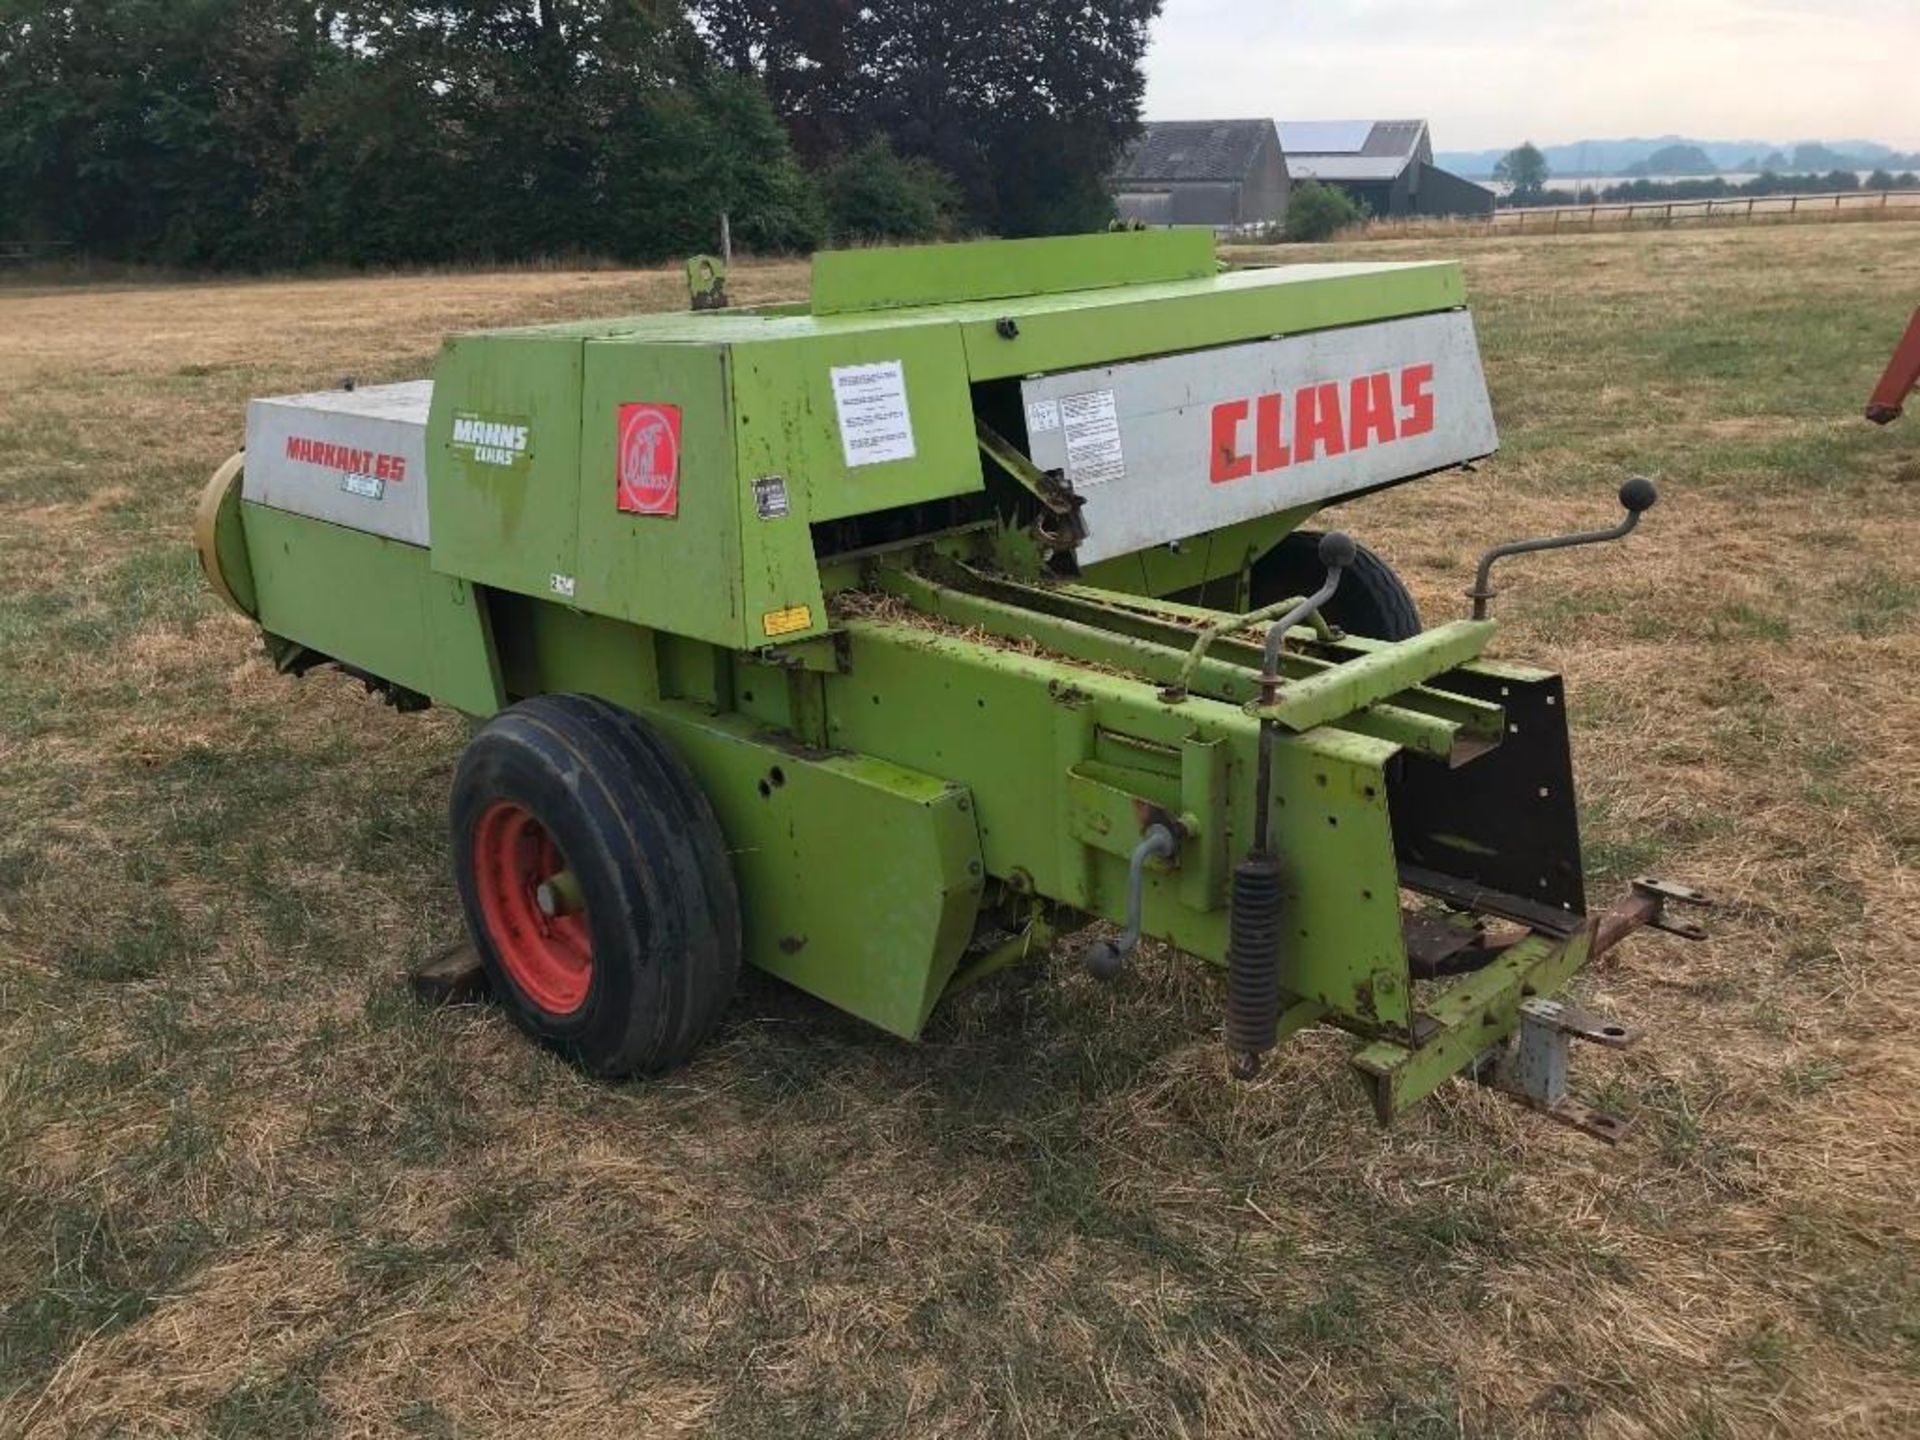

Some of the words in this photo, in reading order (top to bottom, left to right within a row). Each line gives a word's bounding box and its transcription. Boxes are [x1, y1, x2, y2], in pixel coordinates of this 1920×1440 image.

[453, 418, 529, 451] MANNS
[1210, 363, 1434, 484] CLAAS
[286, 436, 373, 474] MARKANT
[376, 453, 406, 482] 65
[474, 447, 515, 466] CLAAS
